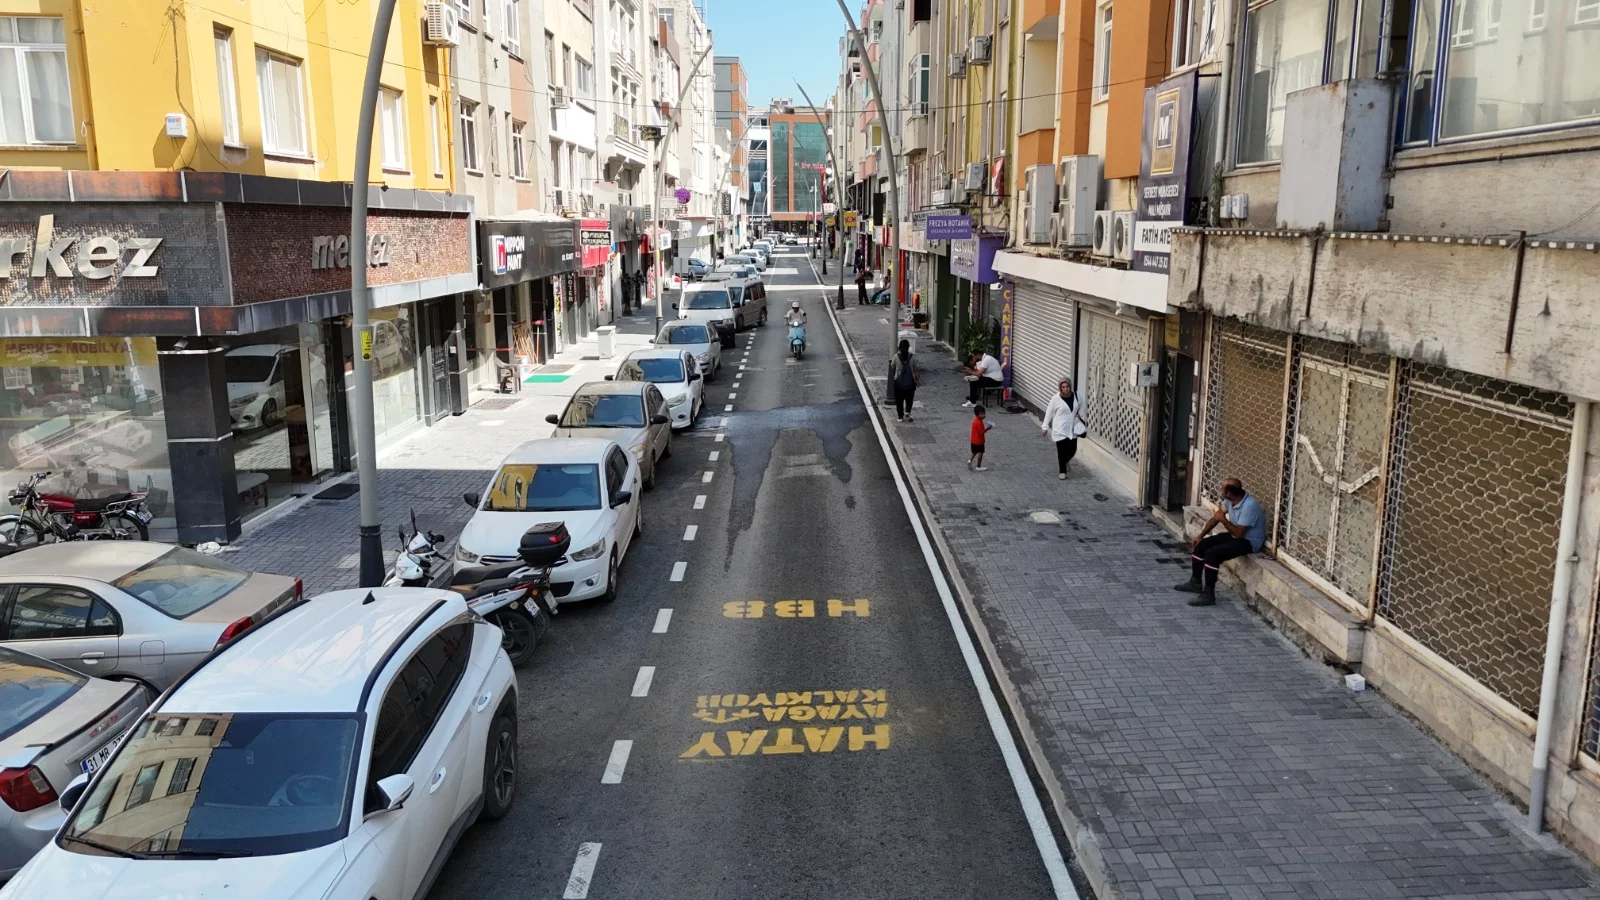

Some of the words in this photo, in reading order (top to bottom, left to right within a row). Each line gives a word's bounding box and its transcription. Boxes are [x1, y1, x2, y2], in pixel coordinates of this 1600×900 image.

[928, 219, 947, 227] FREZYA
[948, 218, 970, 227] BOTANİK
[1141, 225, 1159, 244] FATİH
[504, 236, 525, 252] NIPPON
[507, 253, 523, 271] PAINT
[722, 599, 870, 619] HBB
[678, 724, 890, 758] HATAY
[87, 757, 98, 772] 31
